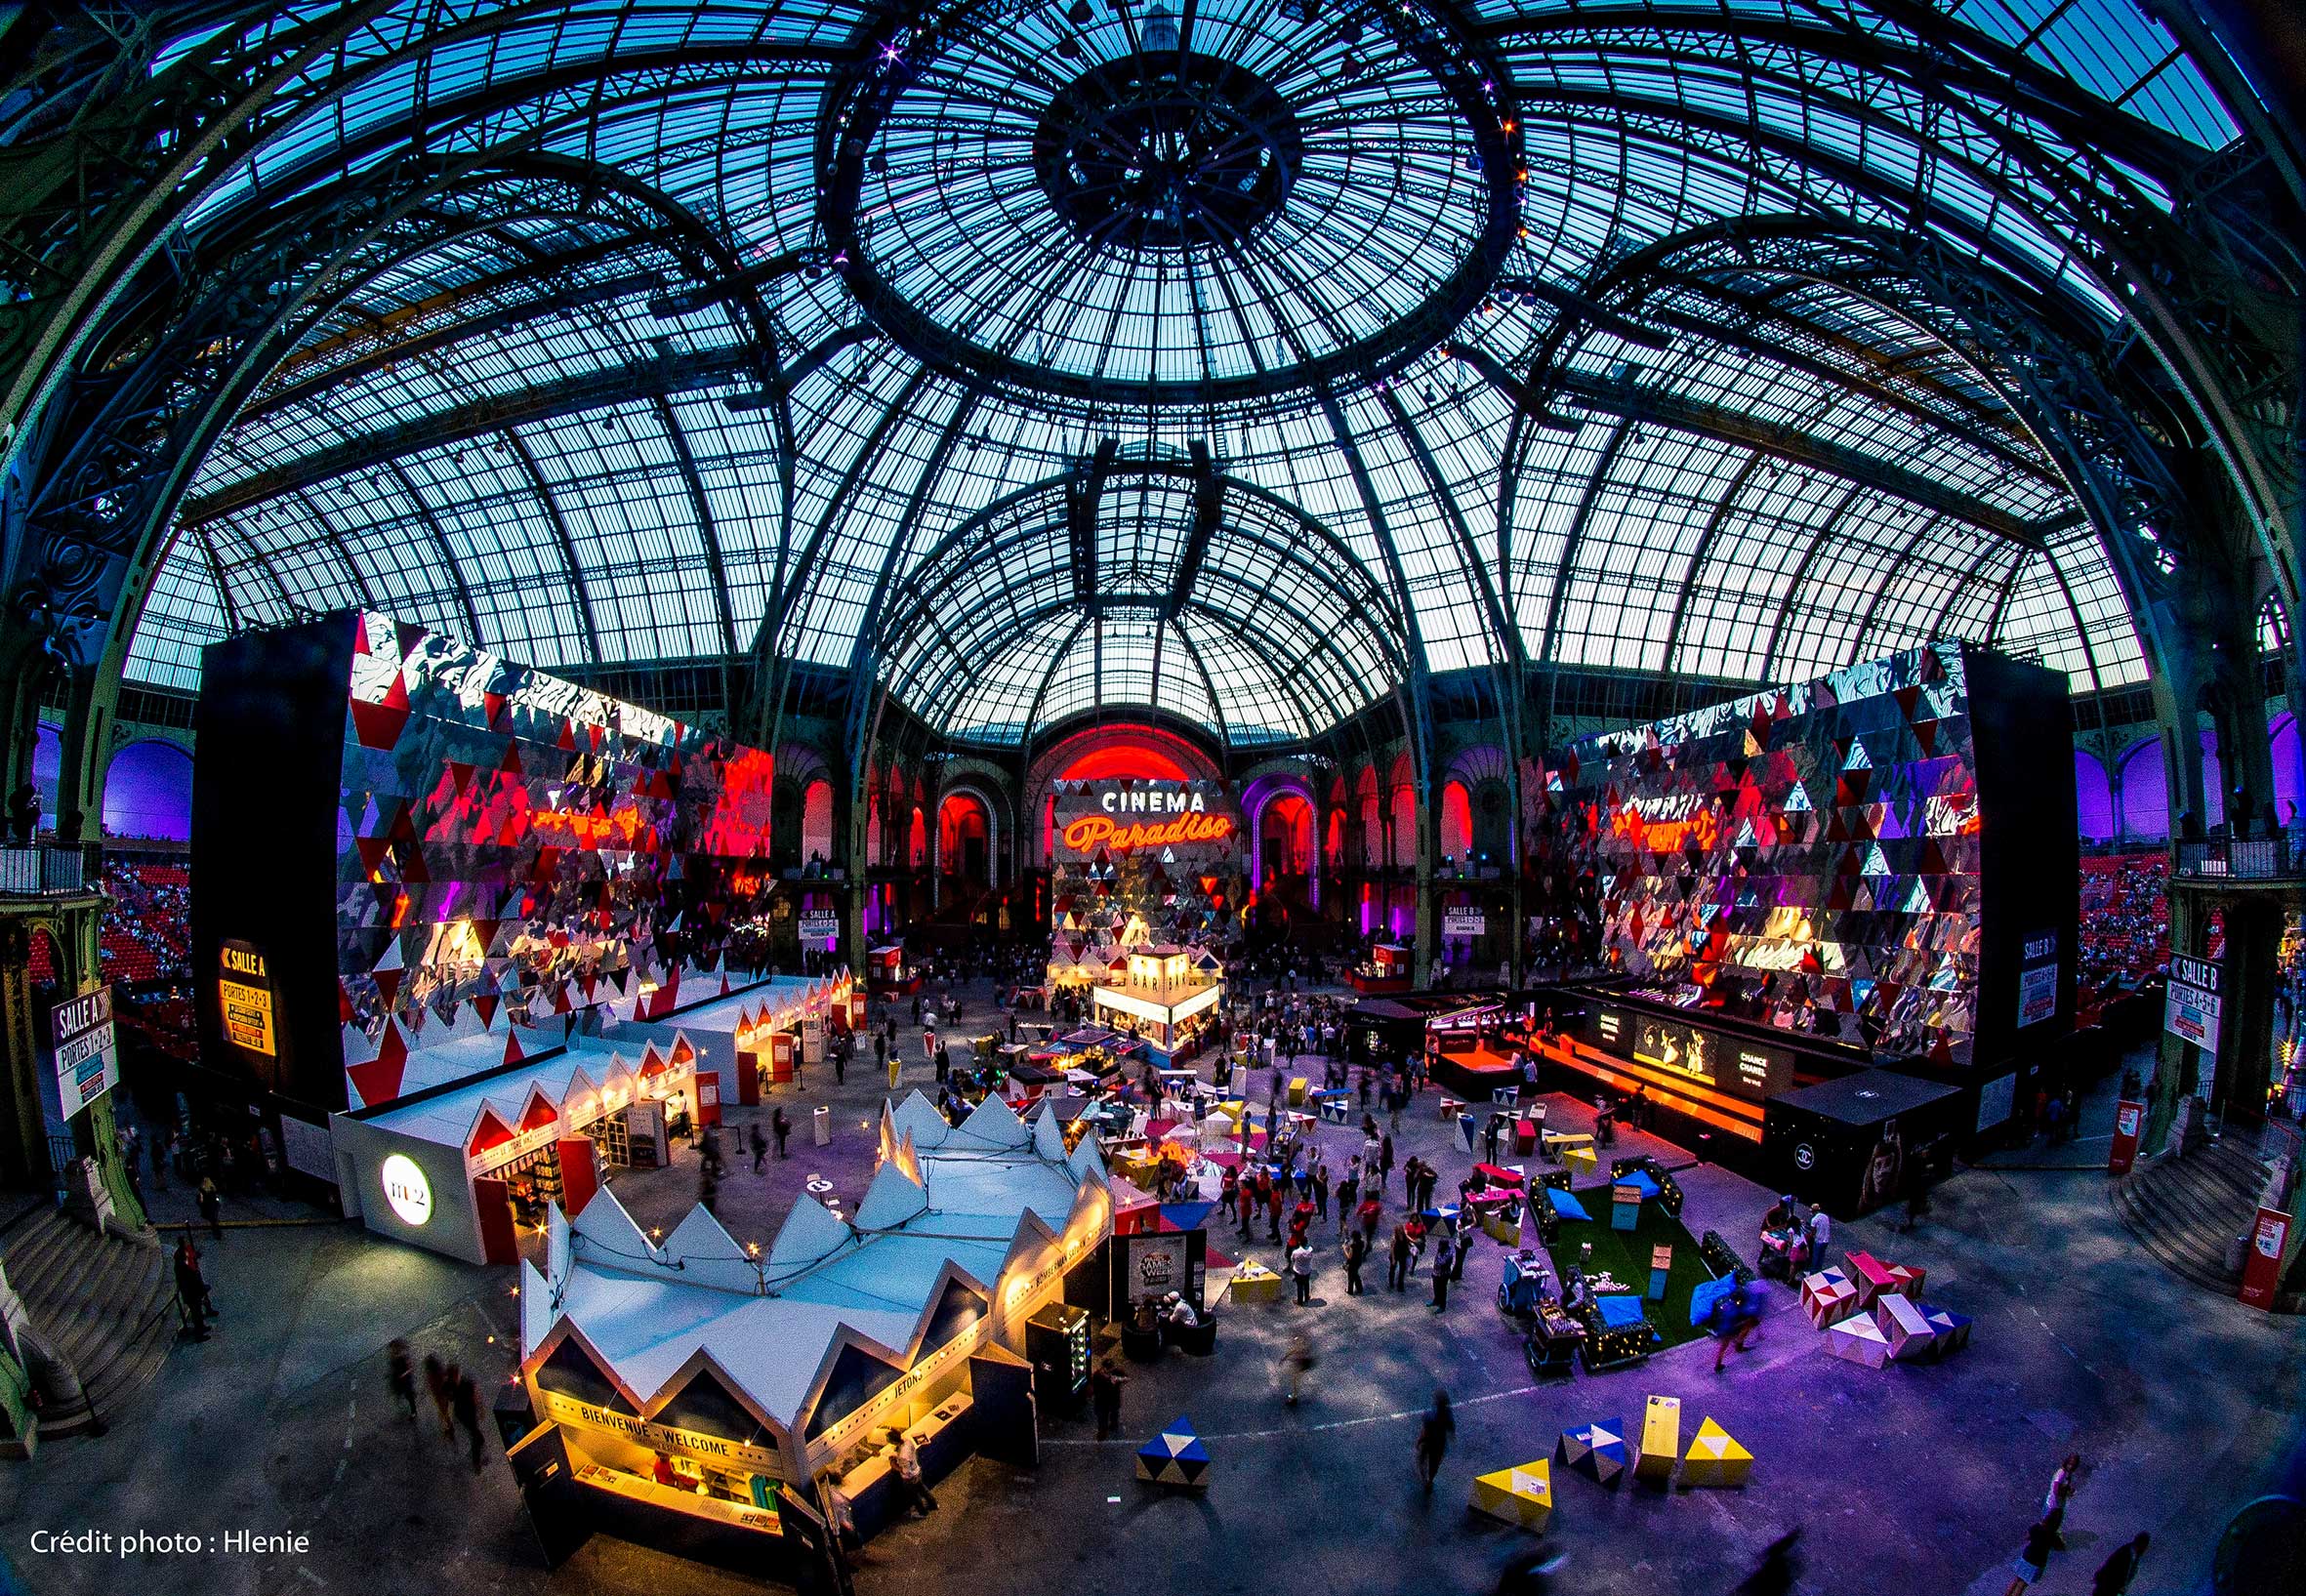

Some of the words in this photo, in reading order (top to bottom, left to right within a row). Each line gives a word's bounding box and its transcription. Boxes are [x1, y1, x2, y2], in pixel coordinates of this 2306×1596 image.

[1102, 793, 1205, 812] CINEMA
[1064, 811, 1230, 853] Paradiso
[1449, 907, 1467, 916] SALLE
[2025, 939, 2042, 960] SALLE
[230, 951, 257, 974] SALLE
[259, 957, 266, 976] A
[1132, 973, 1158, 992] BAR
[2181, 959, 2208, 988] SALLE
[2210, 966, 2217, 991] B
[224, 984, 245, 1002] PORTES
[2170, 983, 2194, 1005] PORTES
[60, 1000, 90, 1039] SALLE
[92, 996, 98, 1021] A
[62, 1037, 90, 1070] PORTES
[1741, 1052, 1767, 1067] CHANCE
[1740, 1062, 1766, 1077] CHANEL
[894, 1372, 923, 1398] JETONS
[581, 1408, 649, 1436] BIENVENUE
[663, 1430, 730, 1456] WELCOME
